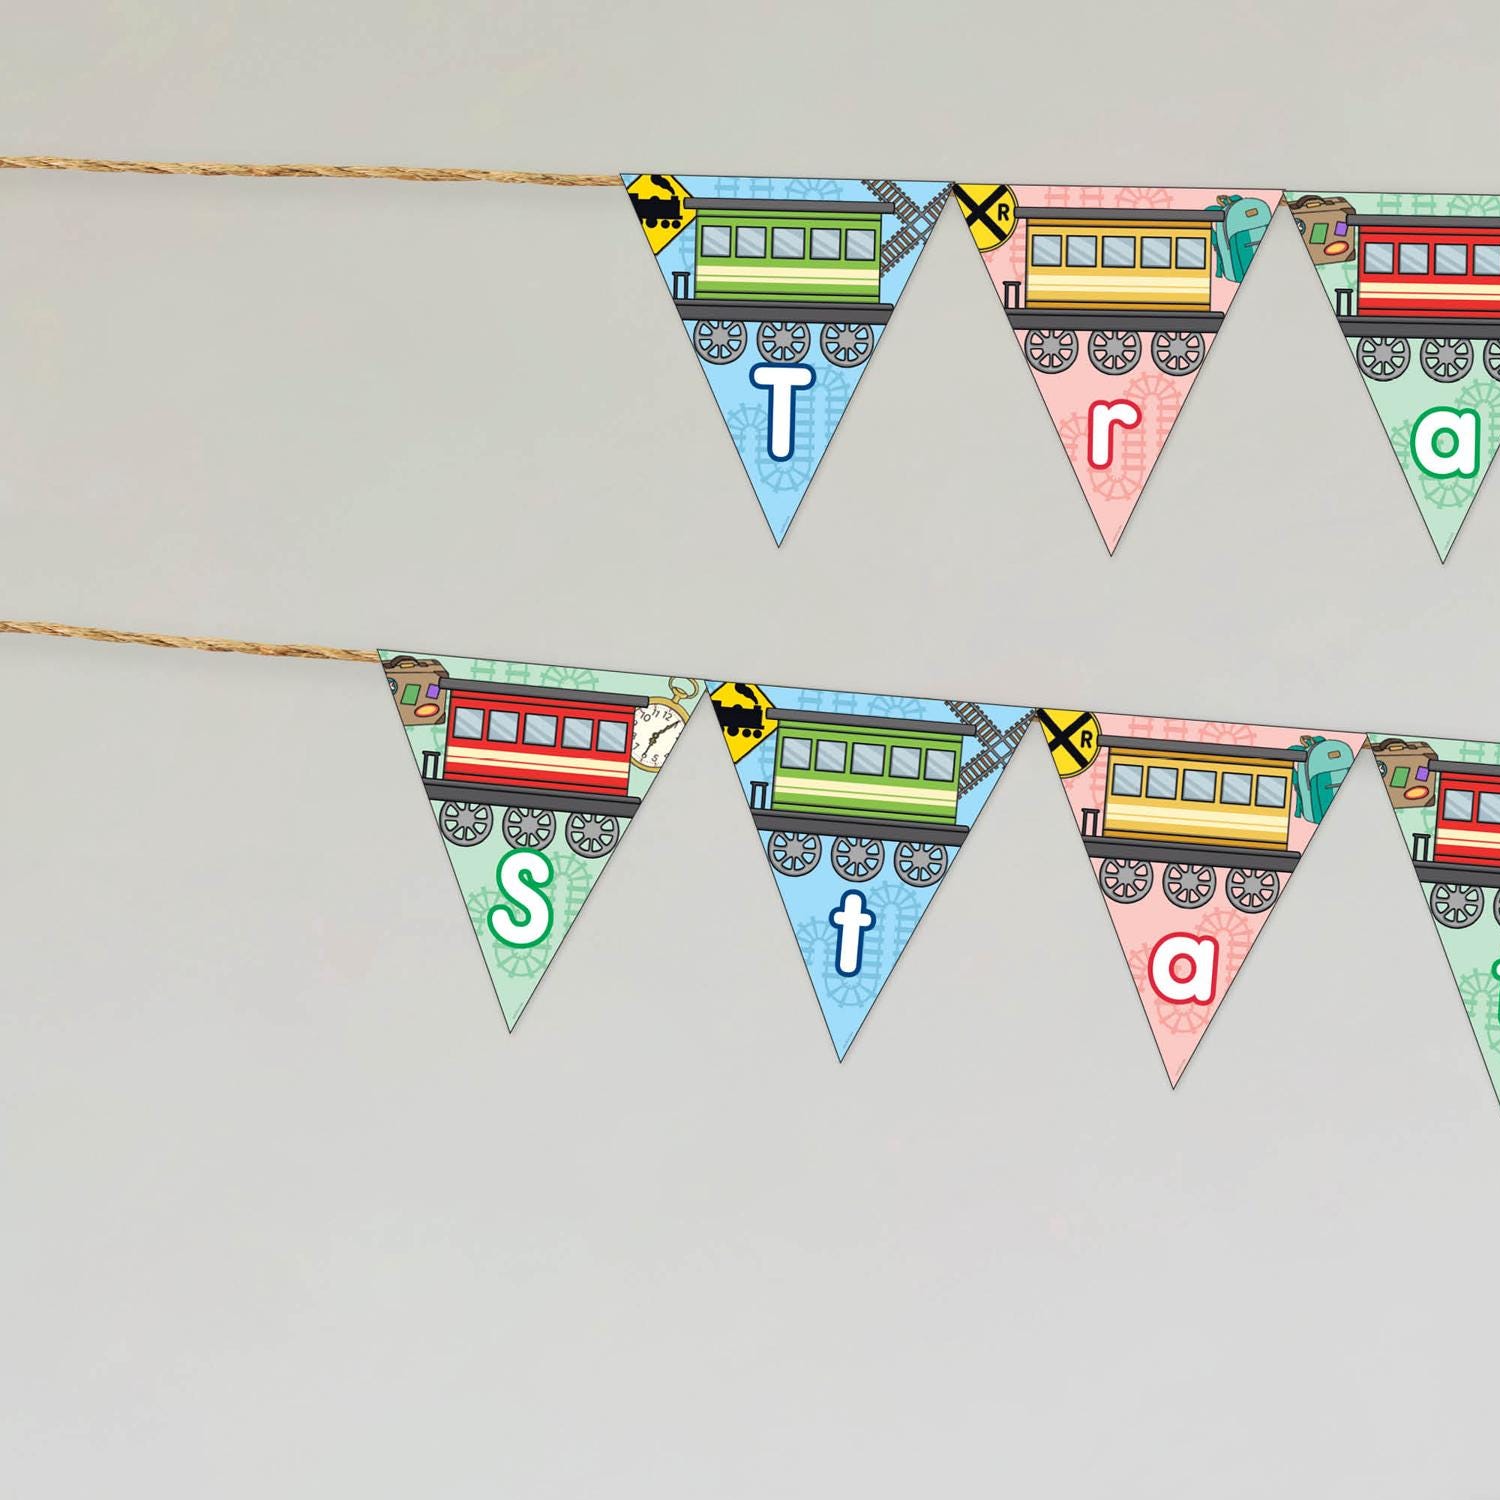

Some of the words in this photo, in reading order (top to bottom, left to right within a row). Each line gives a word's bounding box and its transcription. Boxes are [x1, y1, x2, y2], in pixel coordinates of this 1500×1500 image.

[998, 203, 1010, 221] R
[640, 711, 651, 722] 10
[652, 709, 660, 718] 11
[662, 711, 673, 721] 12
[1081, 730, 1093, 748] R
[651, 754, 659, 762] 5
